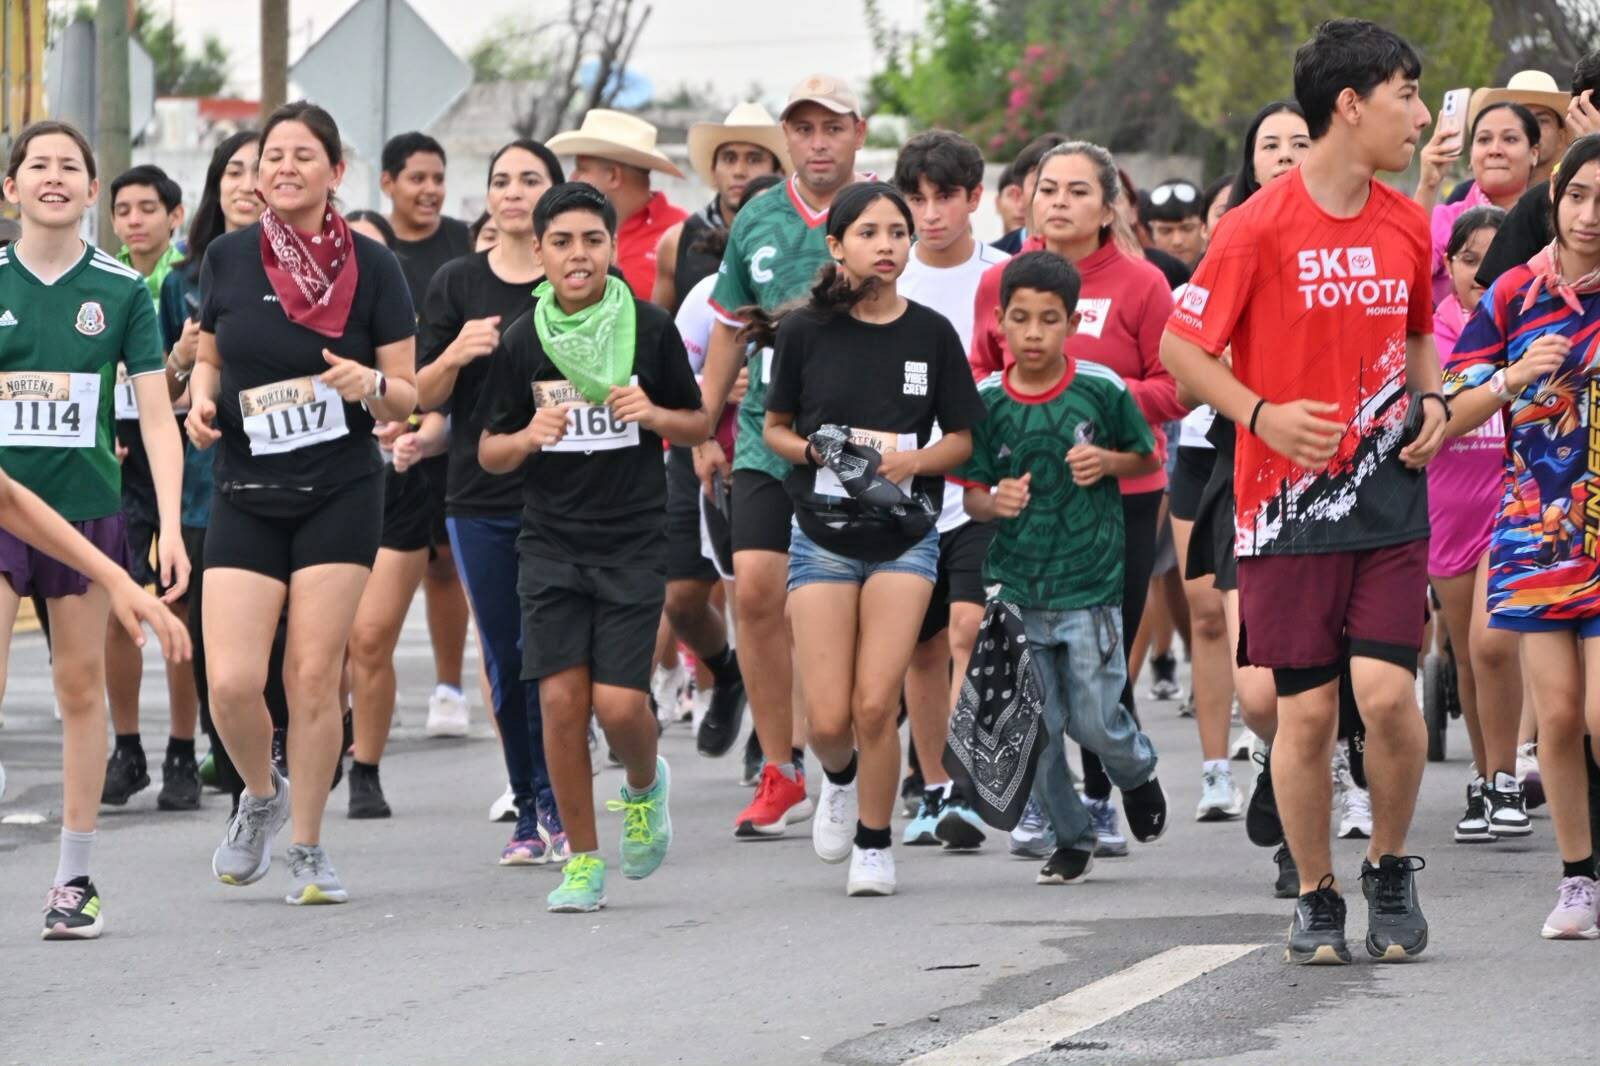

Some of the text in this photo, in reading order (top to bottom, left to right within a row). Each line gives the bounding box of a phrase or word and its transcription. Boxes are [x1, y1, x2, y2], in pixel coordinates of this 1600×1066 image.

[1297, 247, 1347, 281] 5K
[1297, 279, 1408, 309] TOYOTA
[904, 360, 928, 374] GOOD
[904, 371, 928, 385] VIBES
[902, 383, 928, 396] CREW
[14, 401, 80, 432] 1114
[266, 400, 327, 440] 1117
[563, 407, 627, 437] 166
